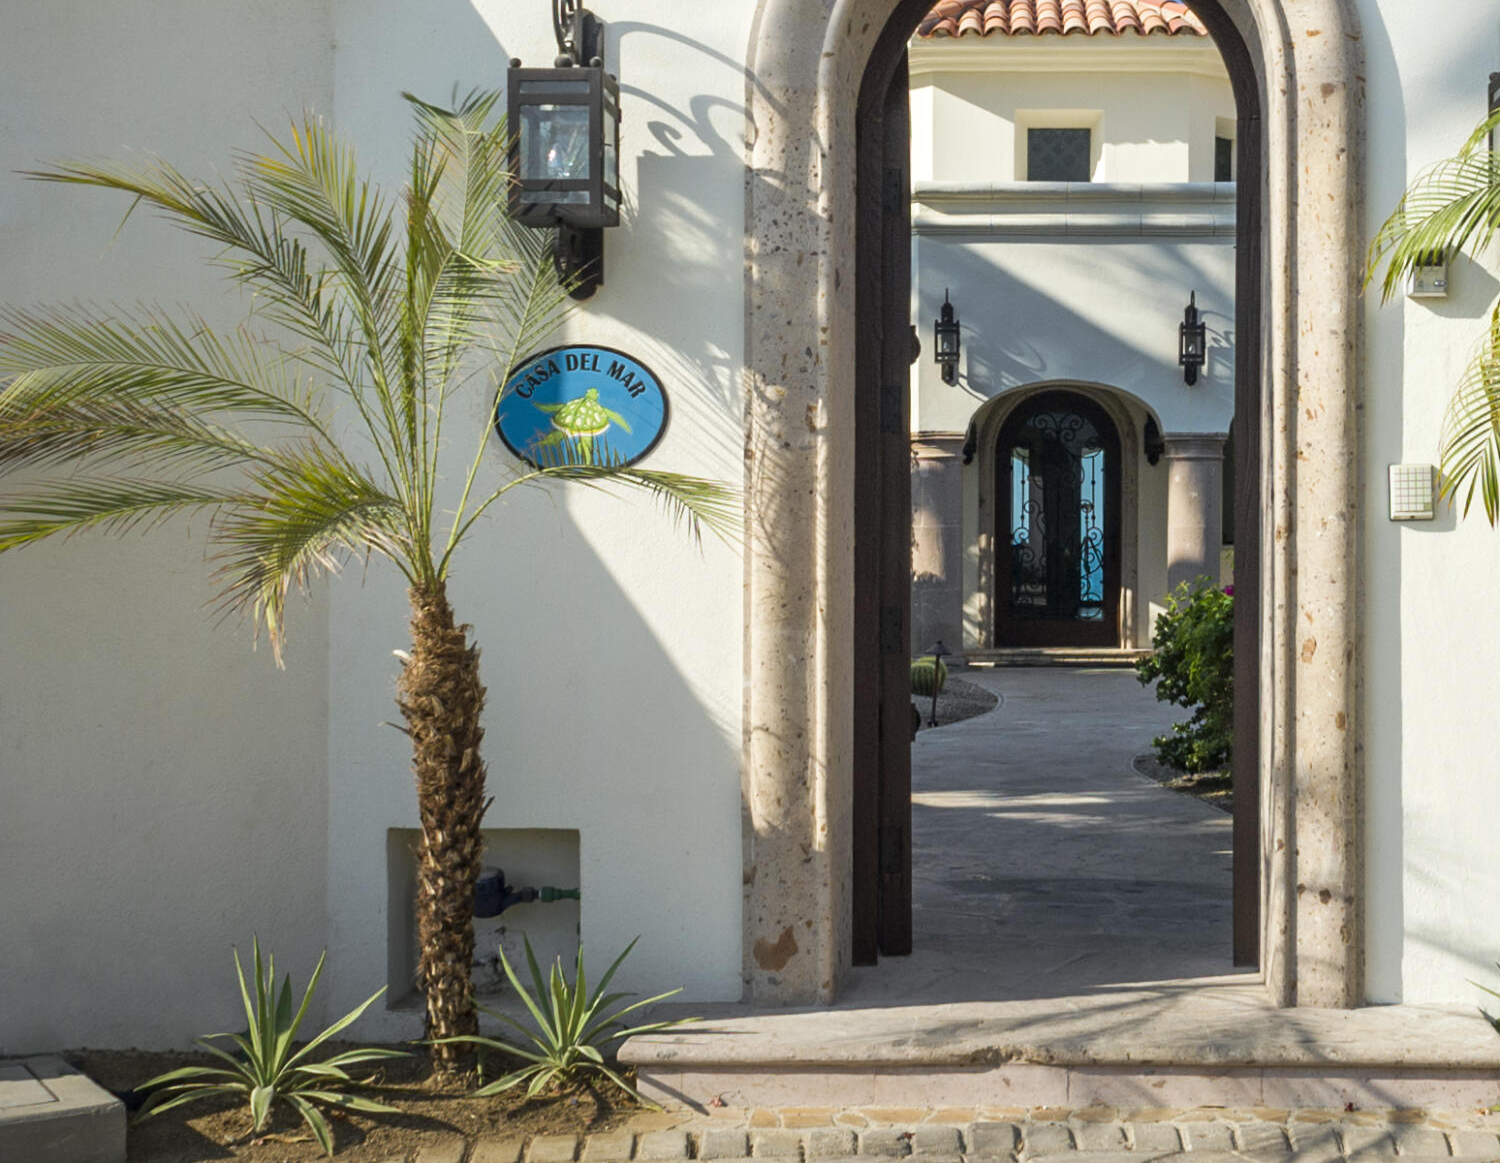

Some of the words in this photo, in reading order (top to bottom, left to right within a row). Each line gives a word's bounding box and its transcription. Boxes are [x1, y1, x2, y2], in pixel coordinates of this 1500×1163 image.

[515, 359, 561, 399] CASA
[565, 353, 601, 372] DEL
[607, 360, 646, 399] MAR
